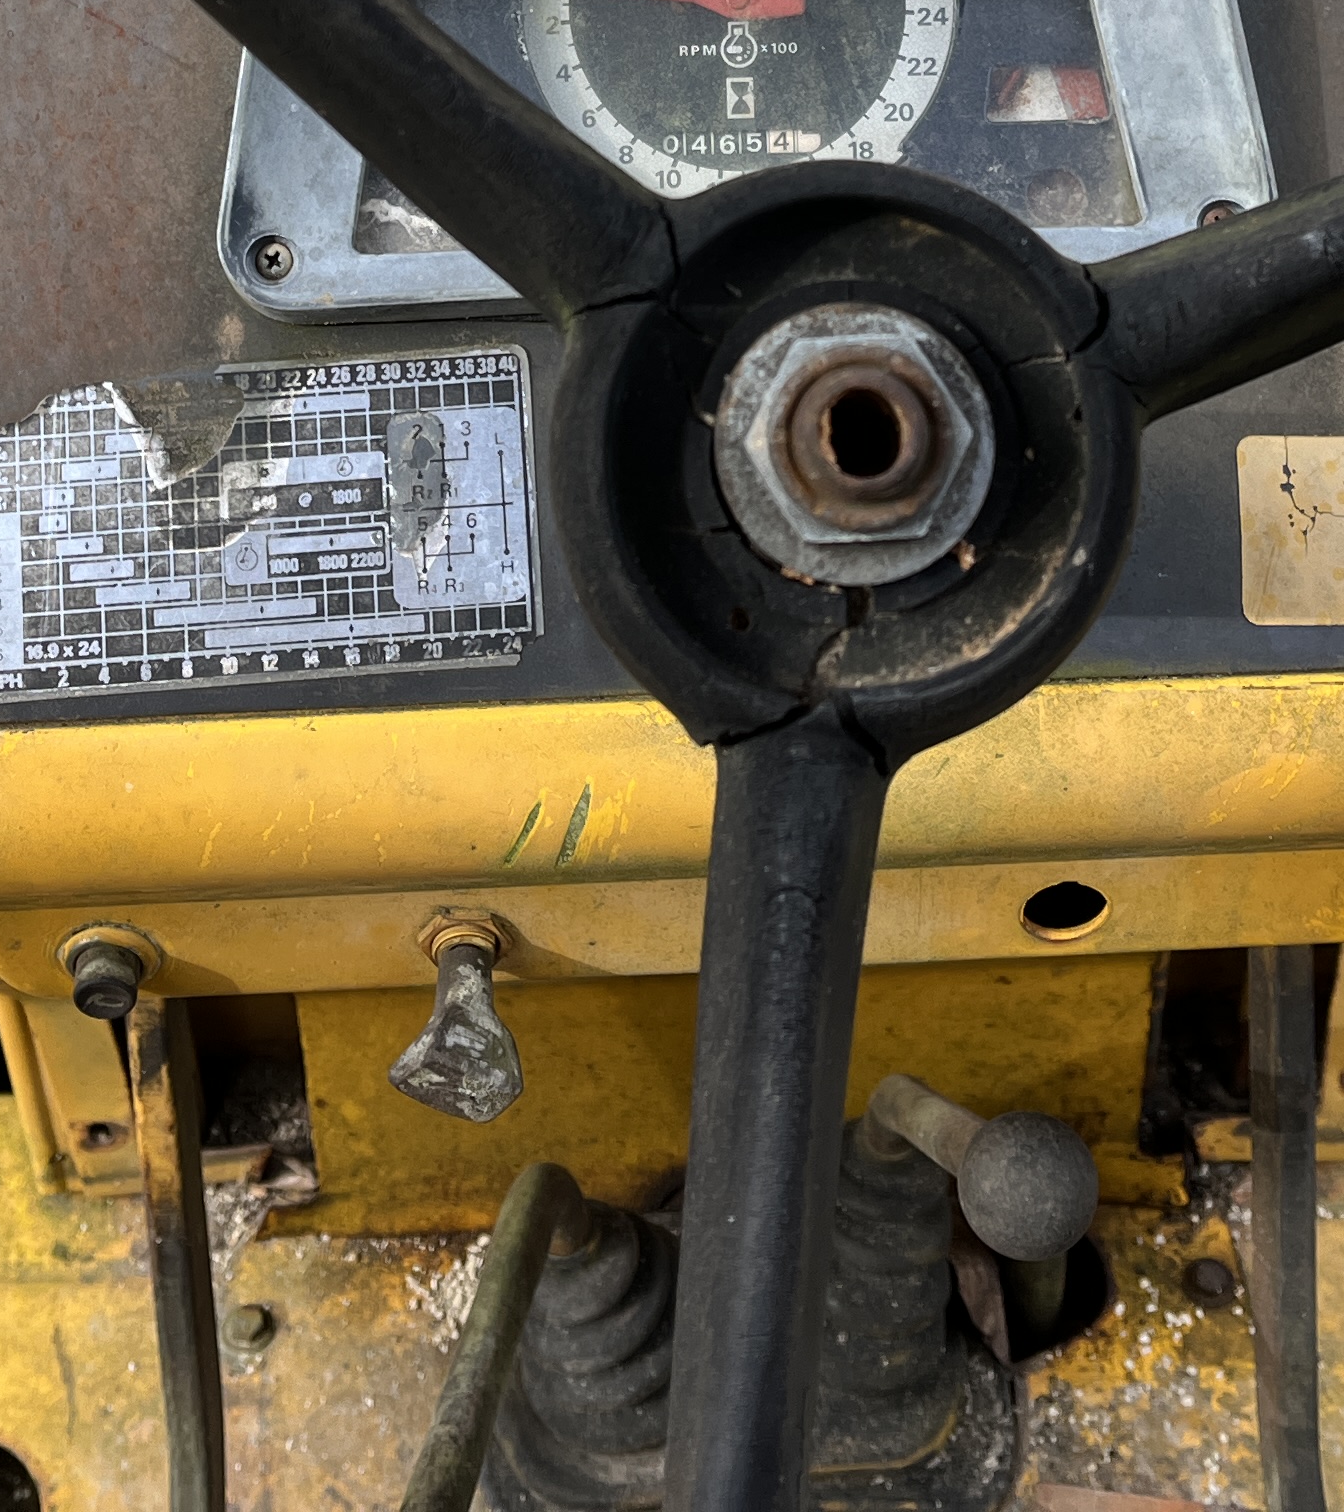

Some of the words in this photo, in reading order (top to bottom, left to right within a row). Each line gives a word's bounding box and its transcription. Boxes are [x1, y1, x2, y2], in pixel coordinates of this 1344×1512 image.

[546, 17, 561, 34] 2
[917, 8, 948, 26] 24
[679, 43, 717, 56] RPM
[556, 65, 571, 82] 4
[907, 57, 938, 76] 22
[582, 110, 596, 129] 6
[884, 103, 914, 122] 20
[619, 146, 634, 164] 8
[848, 141, 874, 159] 18
[655, 170, 681, 189] 10
[257, 371, 276, 389] 20
[281, 370, 301, 387] 22
[307, 368, 327, 386] 24
[331, 366, 351, 385] 26
[356, 364, 376, 383] 28
[381, 362, 401, 381] 30
[406, 360, 426, 379] 32
[430, 358, 450, 377] 34
[455, 357, 474, 375] 36
[477, 356, 496, 374] 38
[460, 421, 472, 436] 3
[495, 432, 504, 445] L
[417, 516, 428, 532] 5
[442, 514, 453, 527] 4
[466, 512, 477, 528] 6
[350, 551, 385, 568] 2200
[501, 560, 515, 574] H
[78, 640, 101, 657] 24
[58, 670, 70, 687] 2
[98, 665, 111, 684] 4
[140, 663, 152, 682] 6
[219, 656, 239, 675] 10
[261, 653, 279, 672] 12
[423, 641, 443, 659] 20
[462, 638, 483, 656] 22
[502, 636, 523, 654] 24
